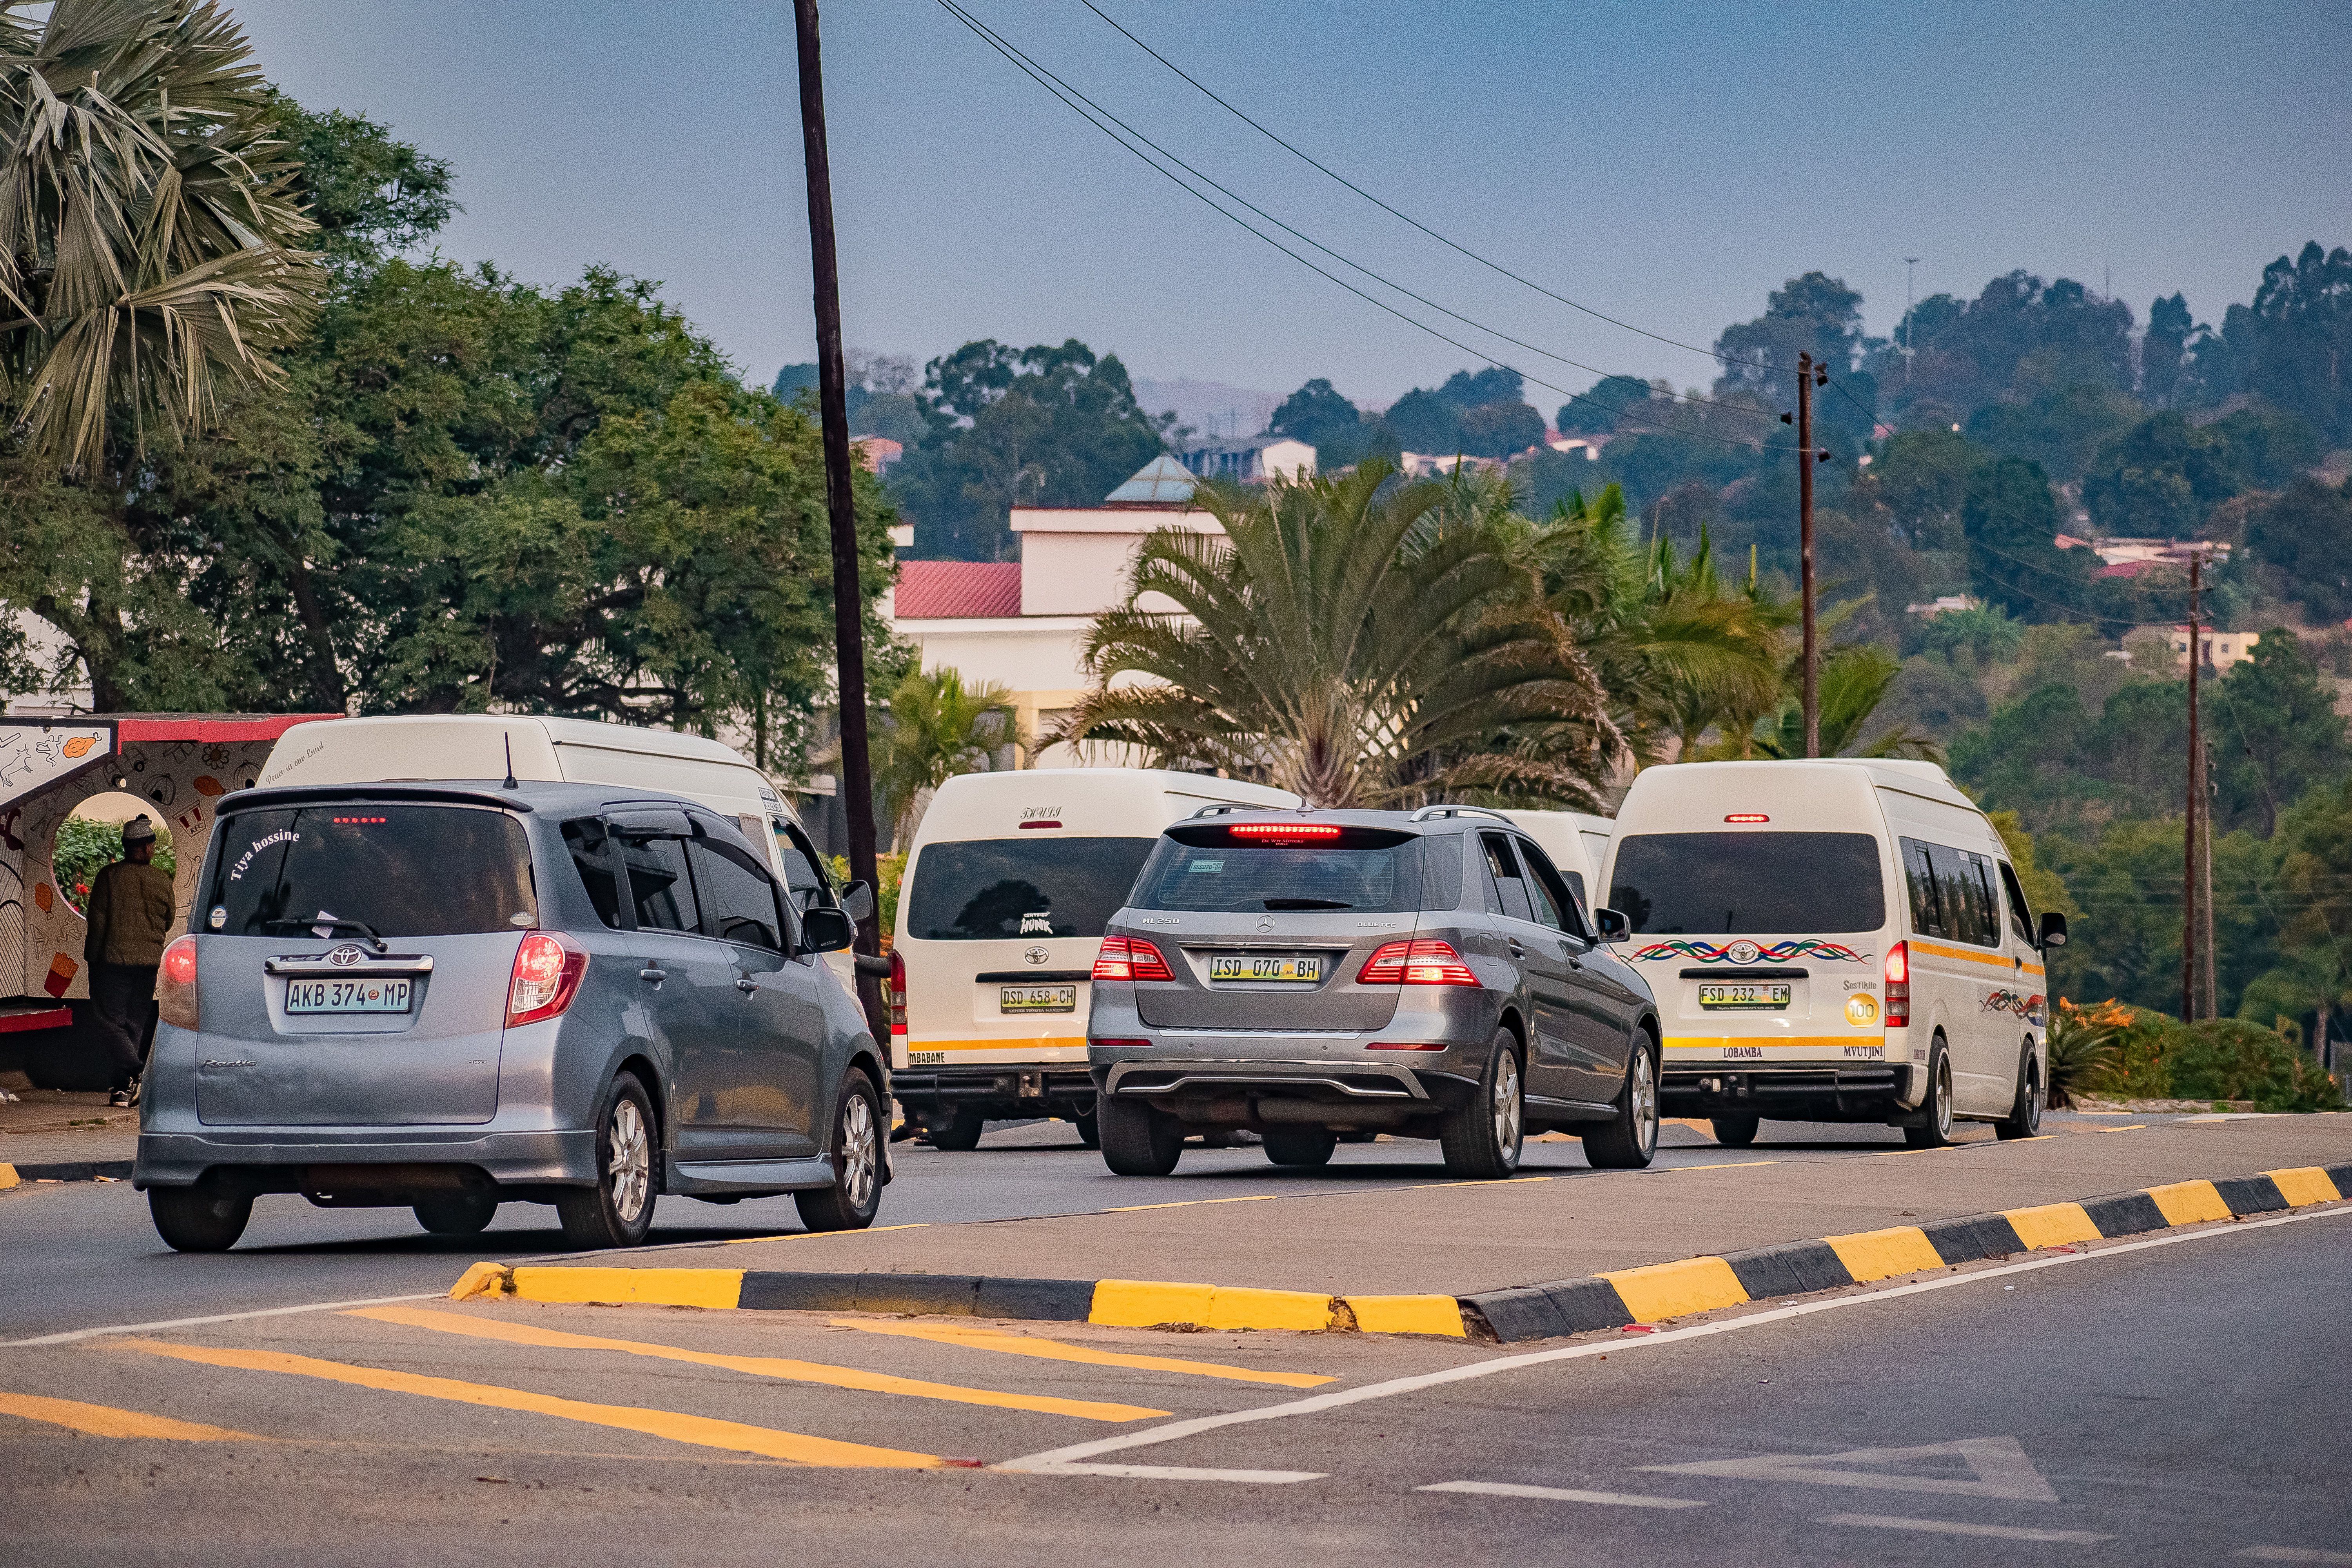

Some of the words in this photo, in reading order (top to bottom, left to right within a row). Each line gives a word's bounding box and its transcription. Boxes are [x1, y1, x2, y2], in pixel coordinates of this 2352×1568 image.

[294, 755, 305, 766] our
[230, 851, 253, 880] Tiya
[252, 828, 299, 853] hossine
[1020, 918, 1053, 934] HUNK
[1214, 959, 1241, 976] ISD
[1253, 960, 1280, 976] 070
[1297, 960, 1316, 978] BH
[290, 984, 325, 1007] AKB
[332, 983, 366, 1006] 374
[384, 983, 407, 1006] MP
[1004, 991, 1023, 1004] DSD
[1030, 990, 1050, 1004] 658
[1060, 990, 1073, 1003] CH
[1702, 987, 1724, 1001] FSD
[1732, 987, 1754, 1001] 232
[1773, 987, 1788, 1001] EM
[1849, 1004, 1874, 1018] 100
[909, 1052, 945, 1063] MBABANE
[1723, 1047, 1762, 1058] LOBAMBA
[1844, 1046, 1883, 1059] MVUTJINI
